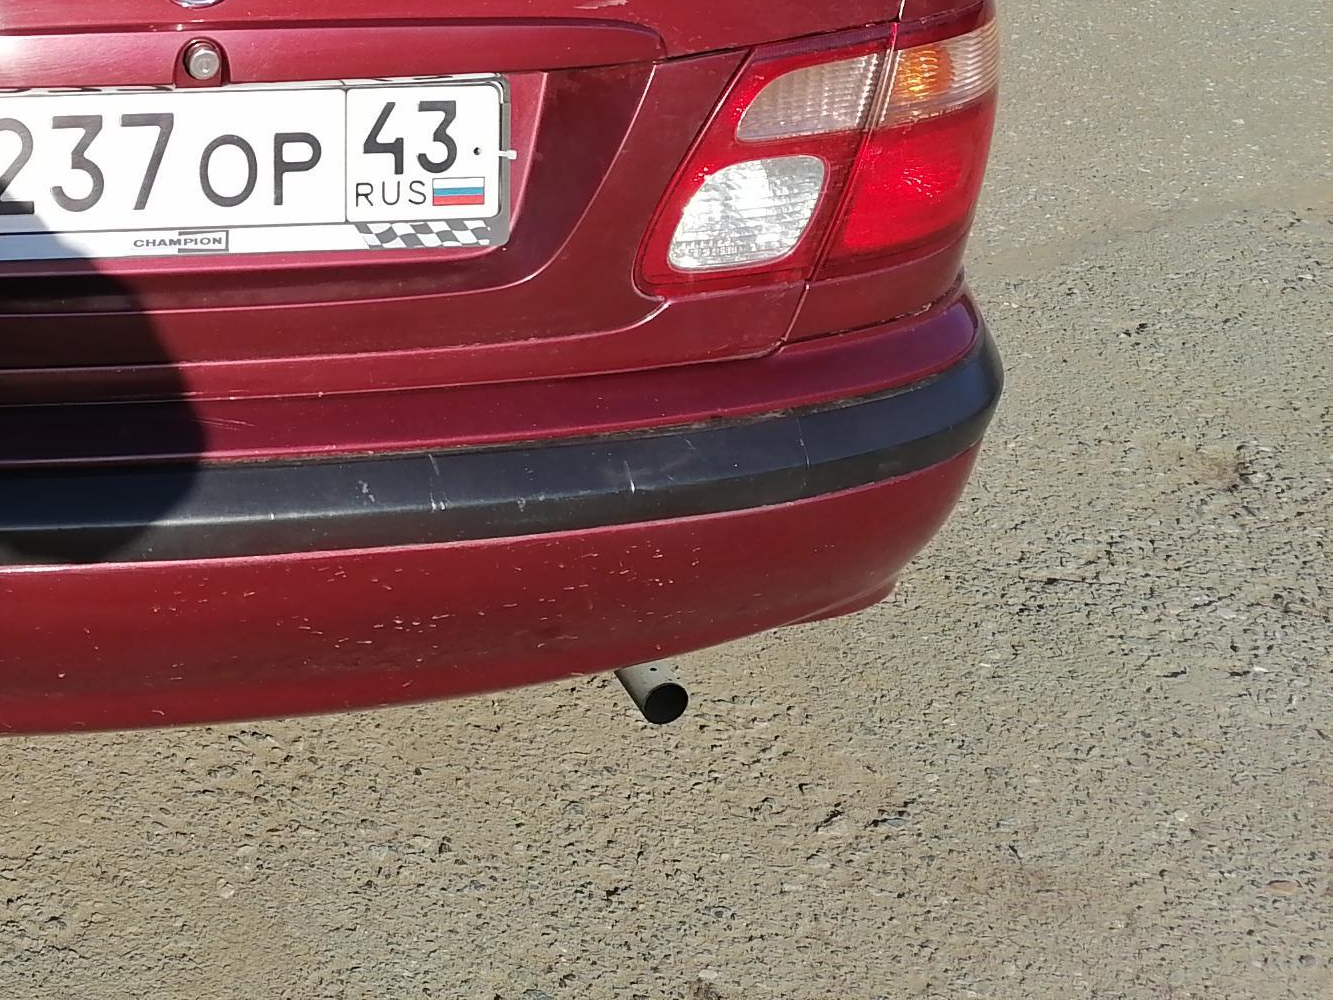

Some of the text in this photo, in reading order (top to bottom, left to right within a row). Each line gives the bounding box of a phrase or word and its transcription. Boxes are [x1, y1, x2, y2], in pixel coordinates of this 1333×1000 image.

[363, 100, 458, 175] 43
[354, 180, 428, 207] RUS
[133, 236, 223, 248] CHAMPION
